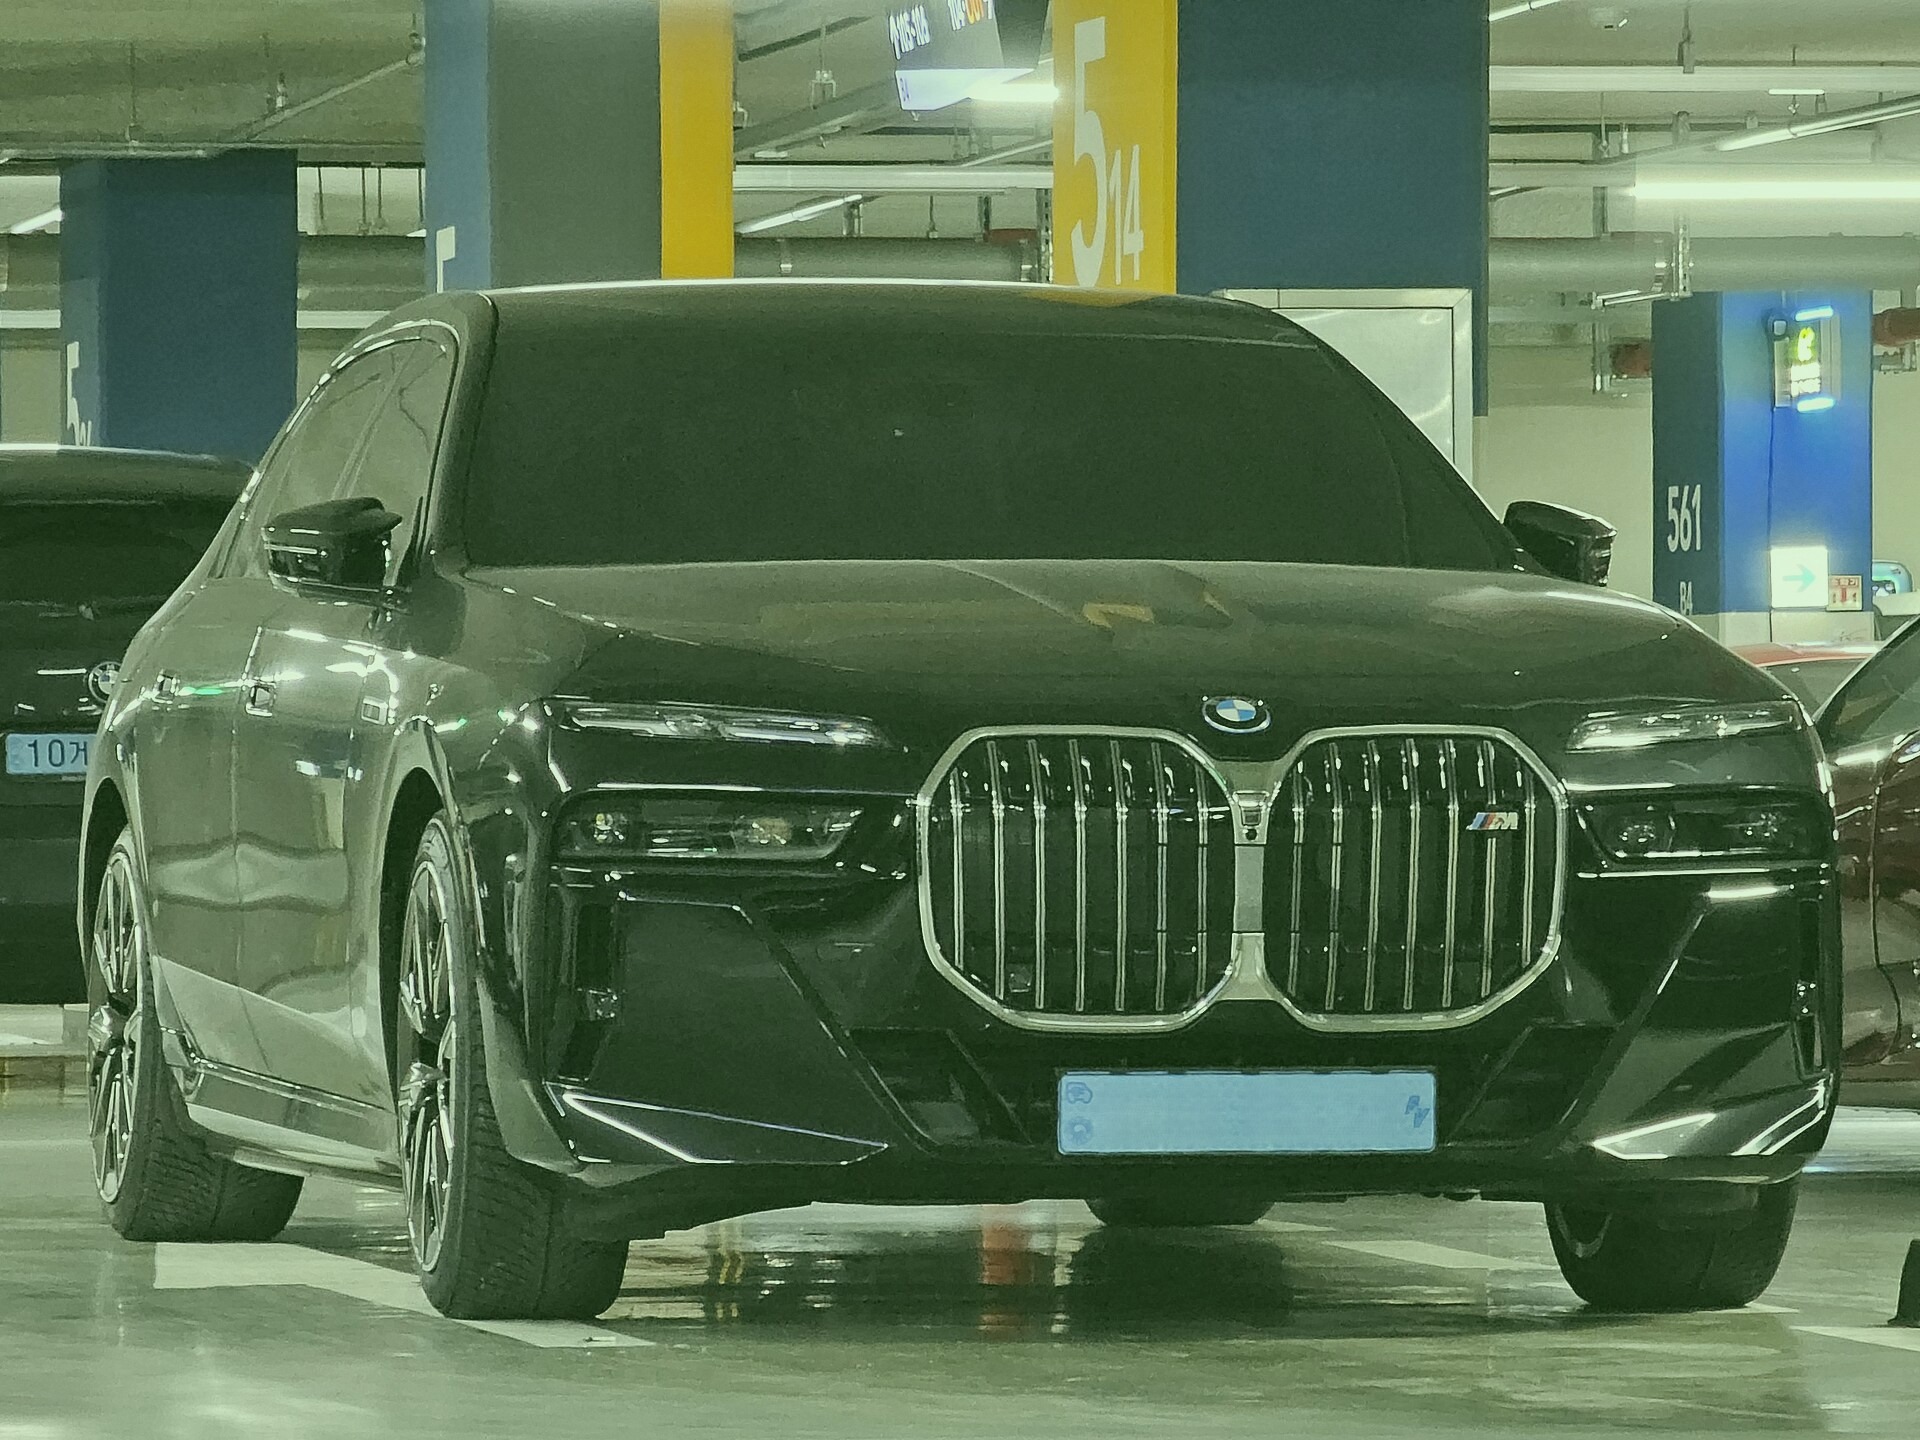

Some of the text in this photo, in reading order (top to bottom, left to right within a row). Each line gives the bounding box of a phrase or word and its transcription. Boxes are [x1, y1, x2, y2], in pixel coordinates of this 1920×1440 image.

[1667, 484, 1701, 553] 561
[1679, 581, 1694, 616] B4
[27, 739, 89, 768] 10거
